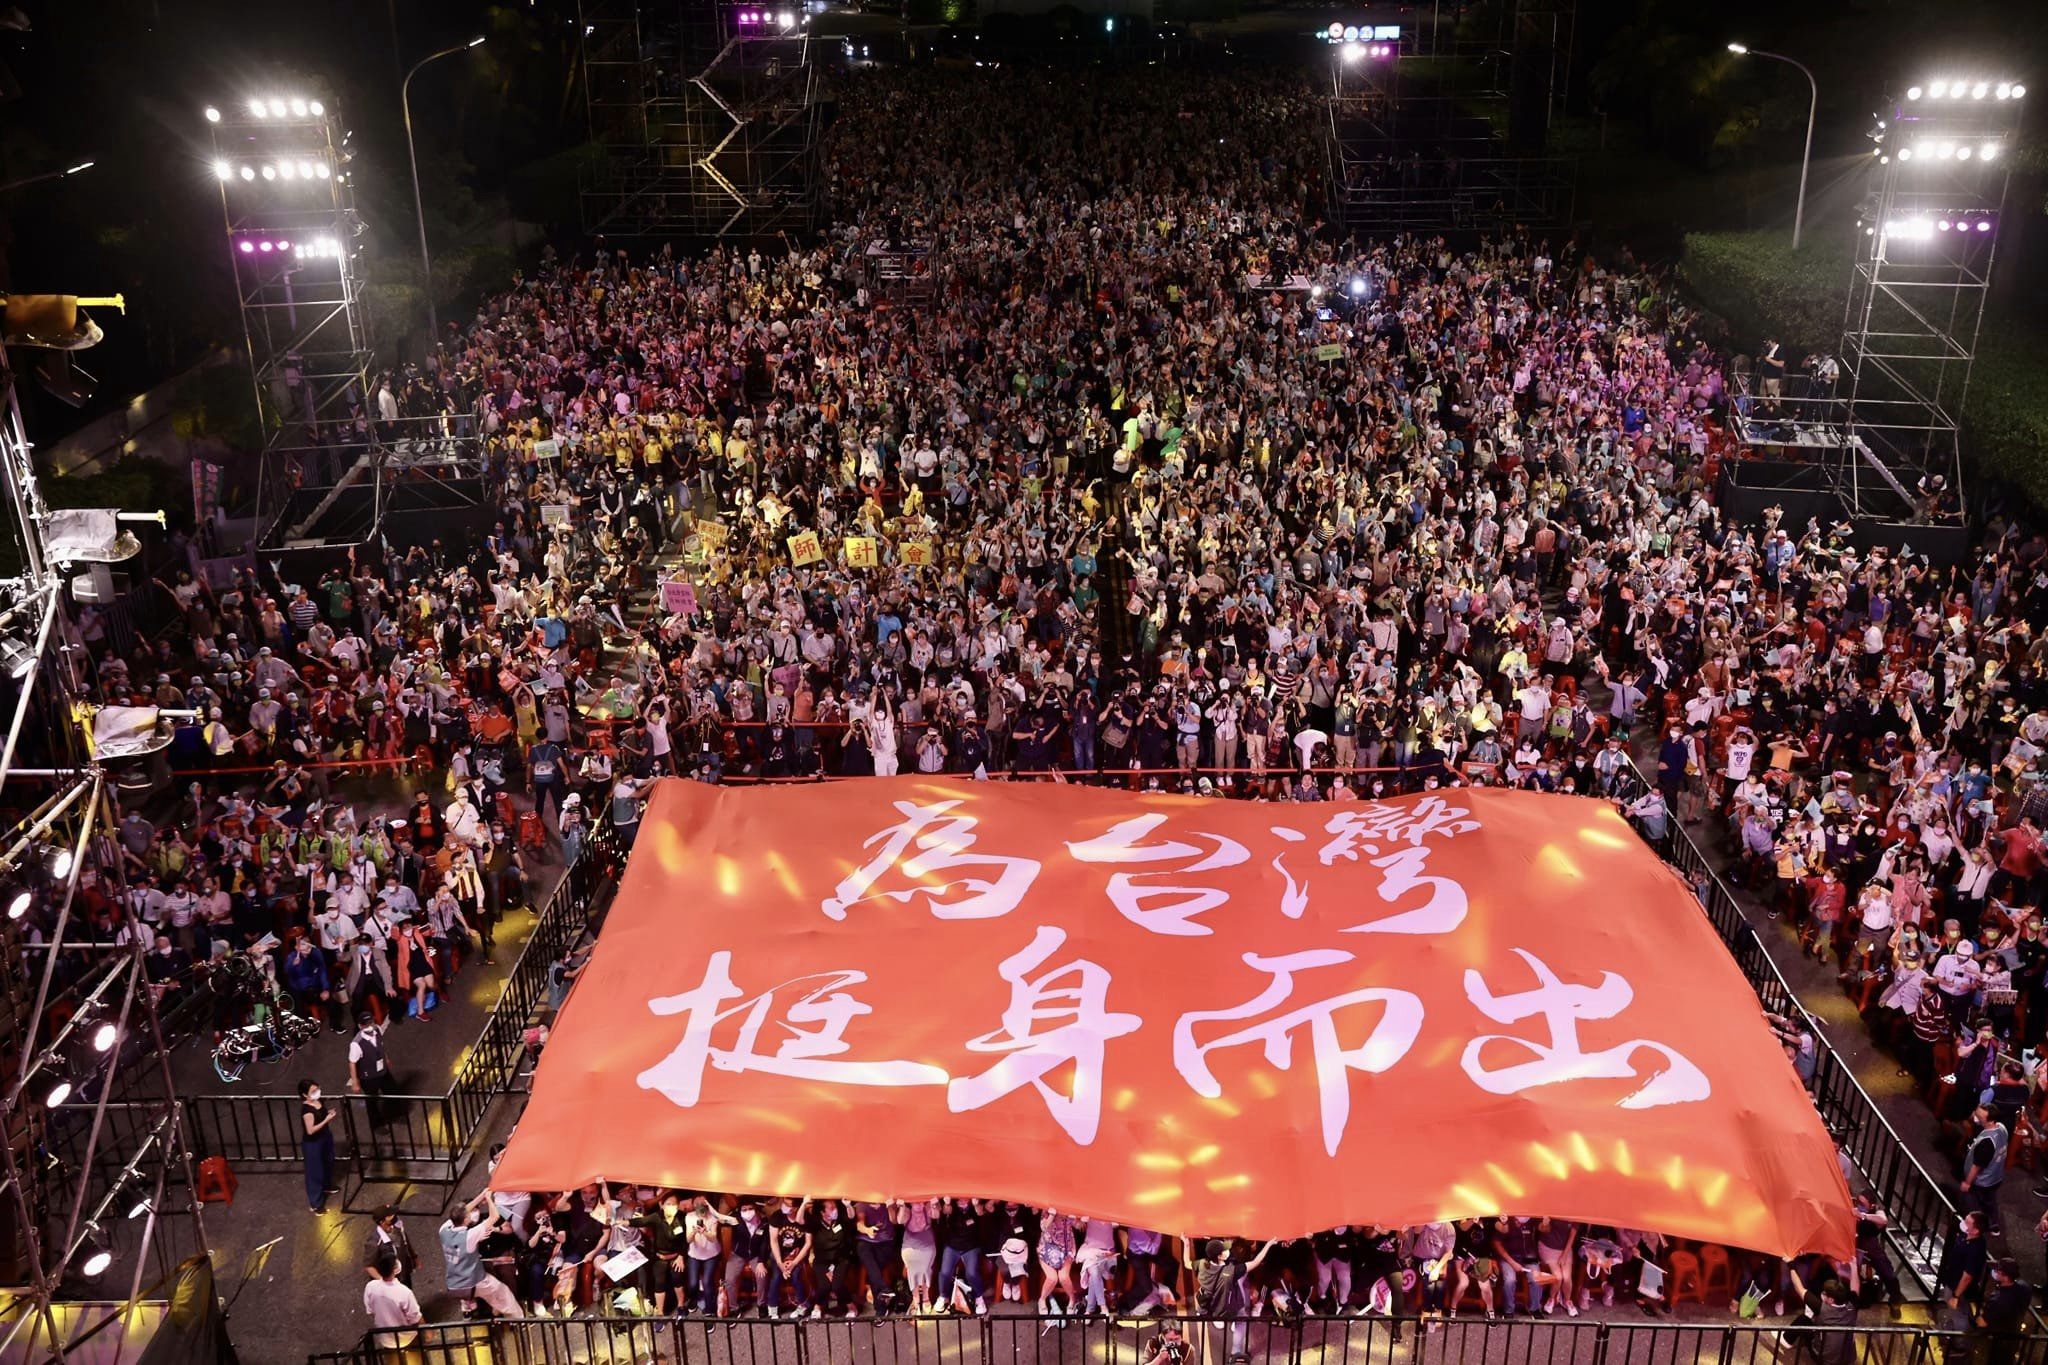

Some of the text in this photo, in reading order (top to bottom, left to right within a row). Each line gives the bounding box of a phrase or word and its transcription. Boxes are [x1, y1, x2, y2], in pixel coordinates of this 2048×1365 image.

[794, 538, 815, 559] 師
[850, 541, 873, 563] 計
[905, 545, 927, 562] 會
[822, 796, 1481, 935] 為台灣
[637, 926, 1710, 1157] 挺身而出
